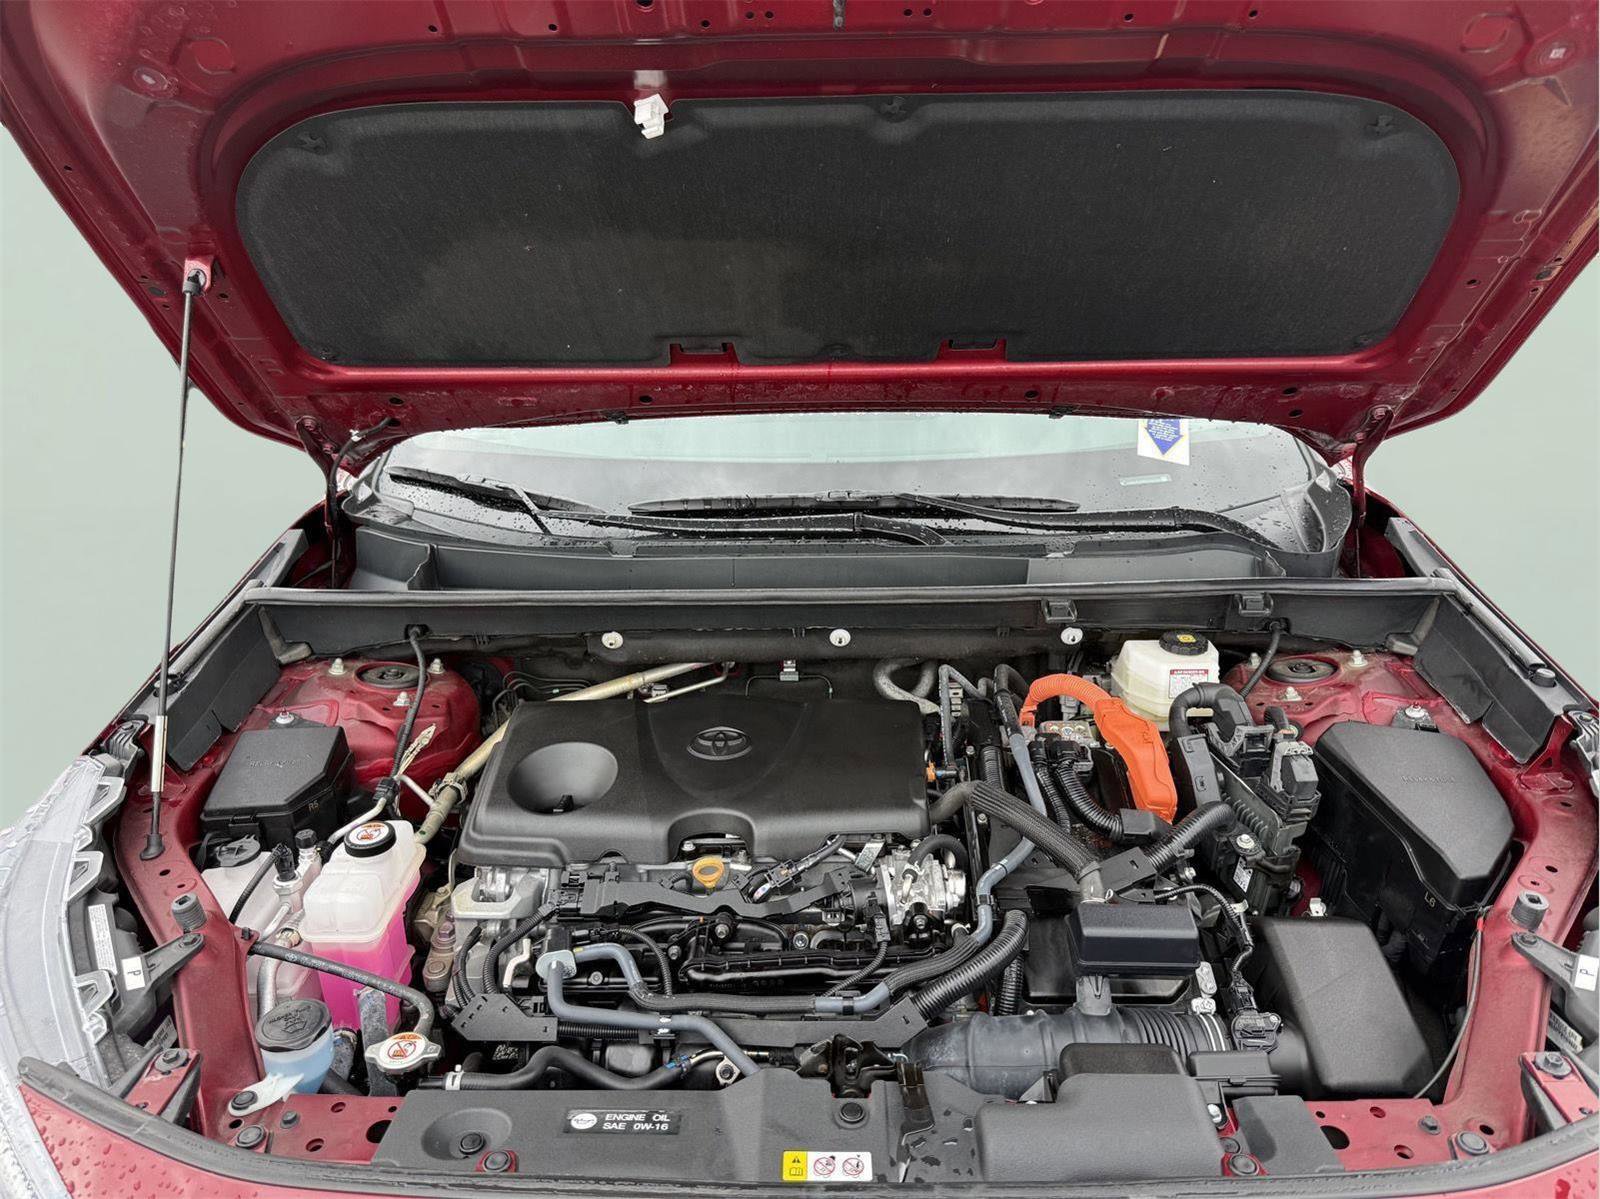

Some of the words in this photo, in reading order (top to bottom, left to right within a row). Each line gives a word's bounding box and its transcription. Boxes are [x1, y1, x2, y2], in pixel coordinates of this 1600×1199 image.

[1579, 968, 1595, 977] P
[605, 1113, 646, 1121] ENGINE
[652, 1113, 671, 1122] OIL
[602, 1122, 626, 1130] SAE
[633, 1123, 669, 1131] 0W-16
